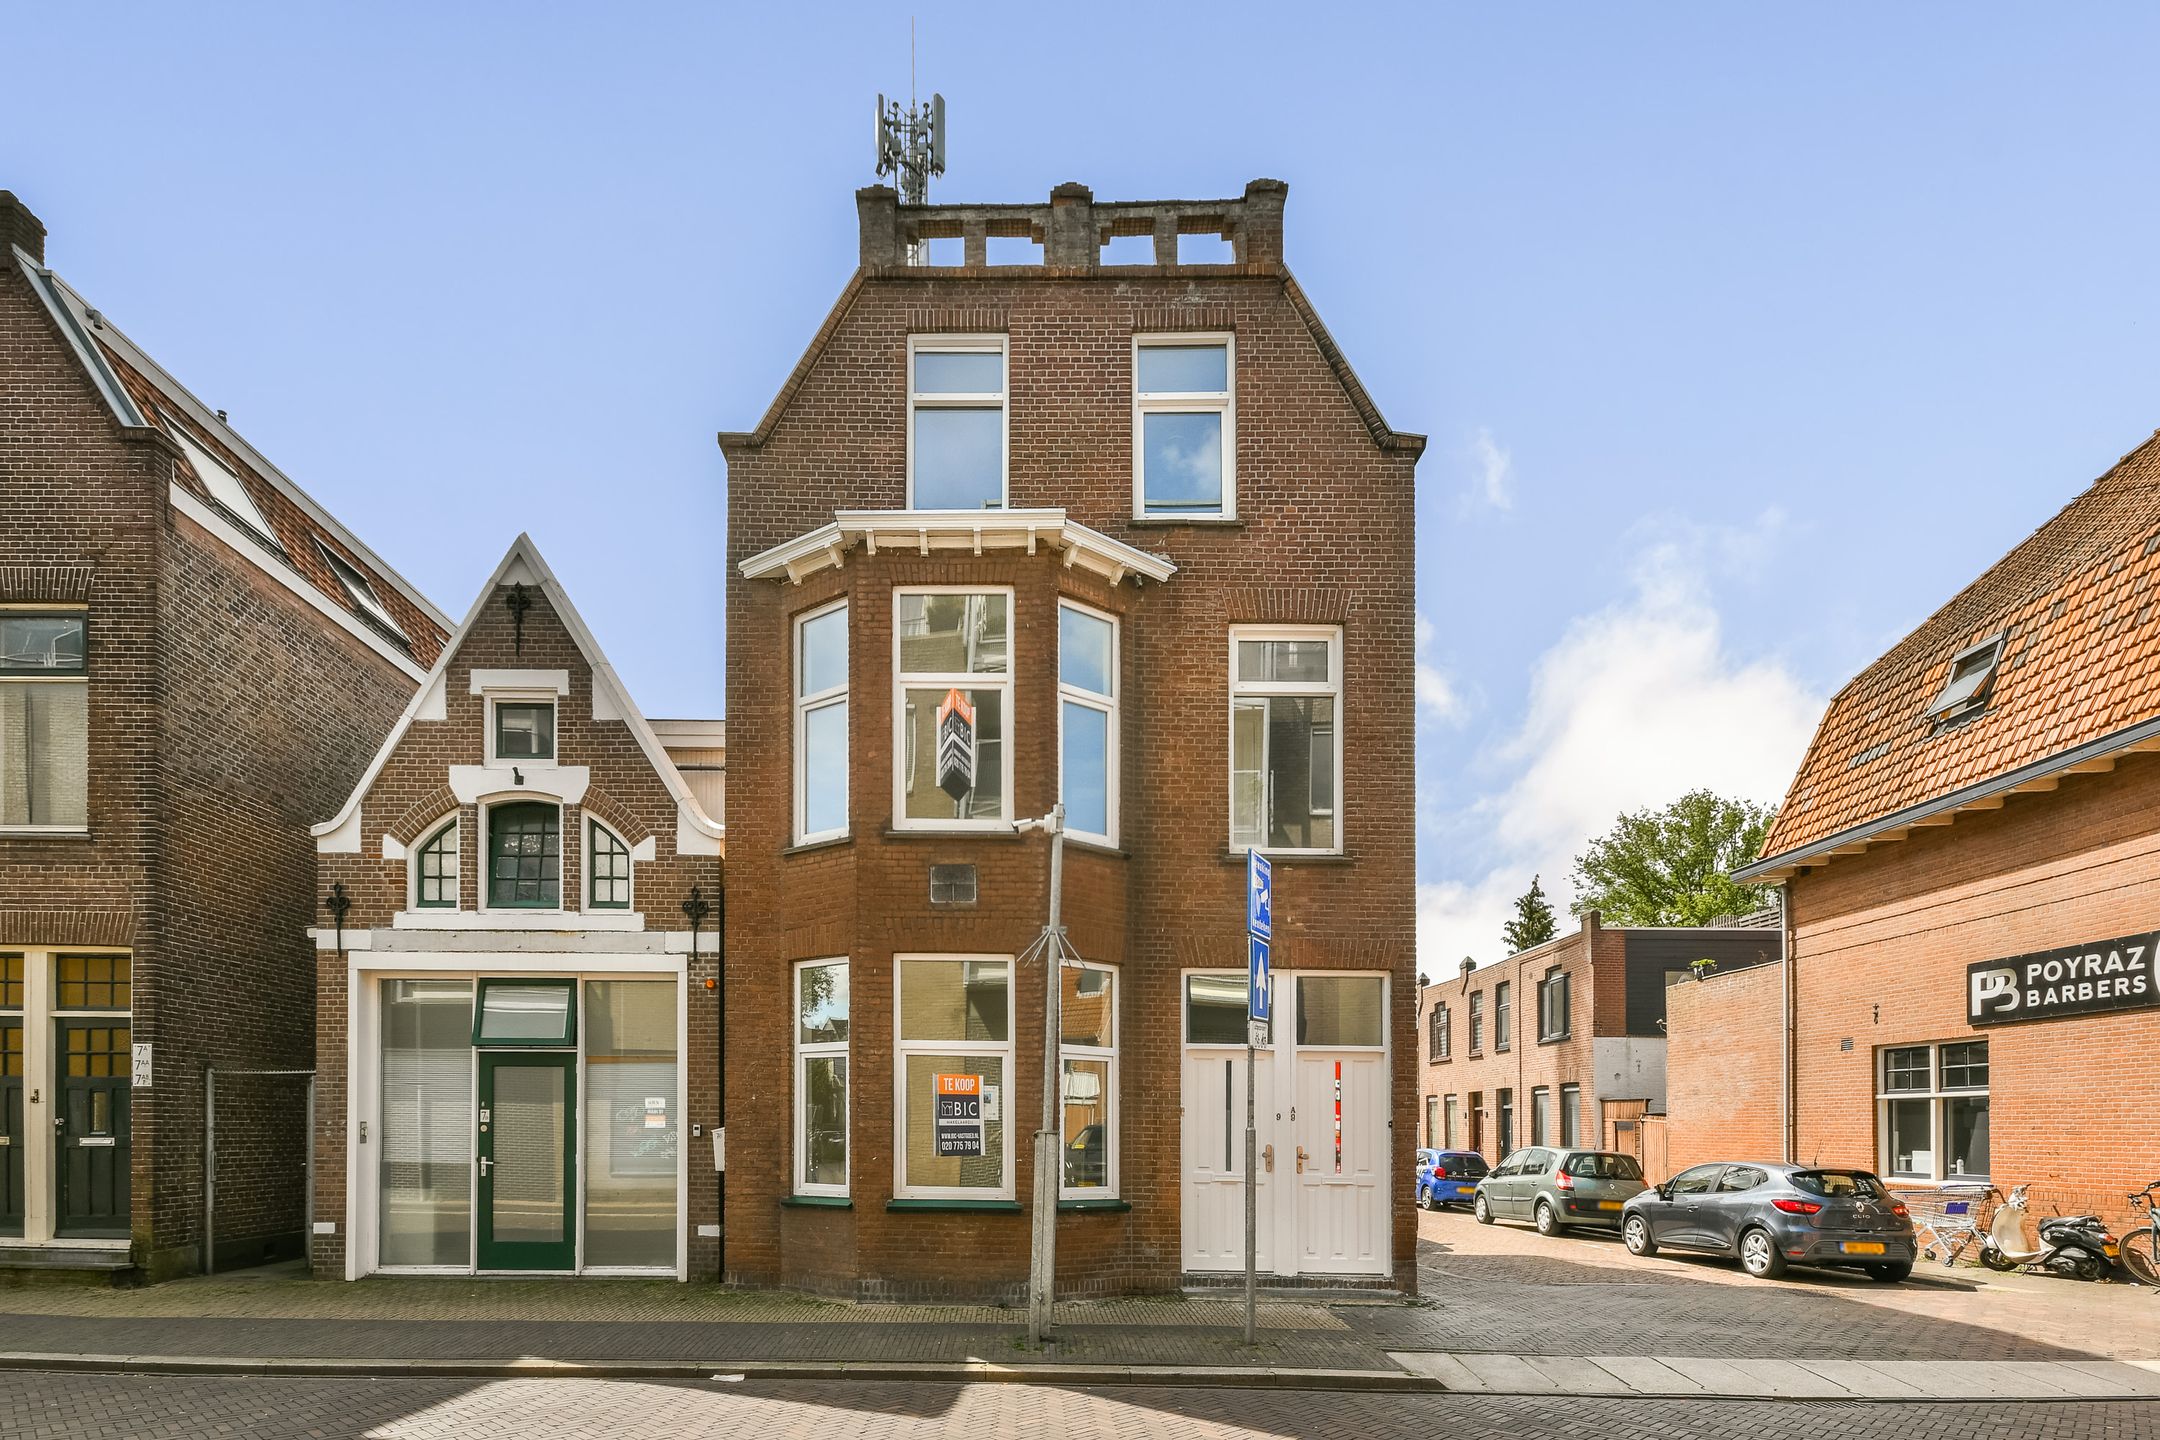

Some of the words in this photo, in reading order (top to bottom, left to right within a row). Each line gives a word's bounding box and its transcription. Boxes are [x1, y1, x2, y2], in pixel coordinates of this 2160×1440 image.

[2026, 945, 2146, 986] POYRAZ
[2026, 975, 2147, 1008] BARBERS
[943, 1078, 954, 1091] TE
[955, 1078, 975, 1091] KOOP
[954, 1101, 978, 1116] BIC
[942, 1142, 952, 1150] 020
[964, 1141, 971, 1150] 79
[972, 1141, 979, 1150] 04
